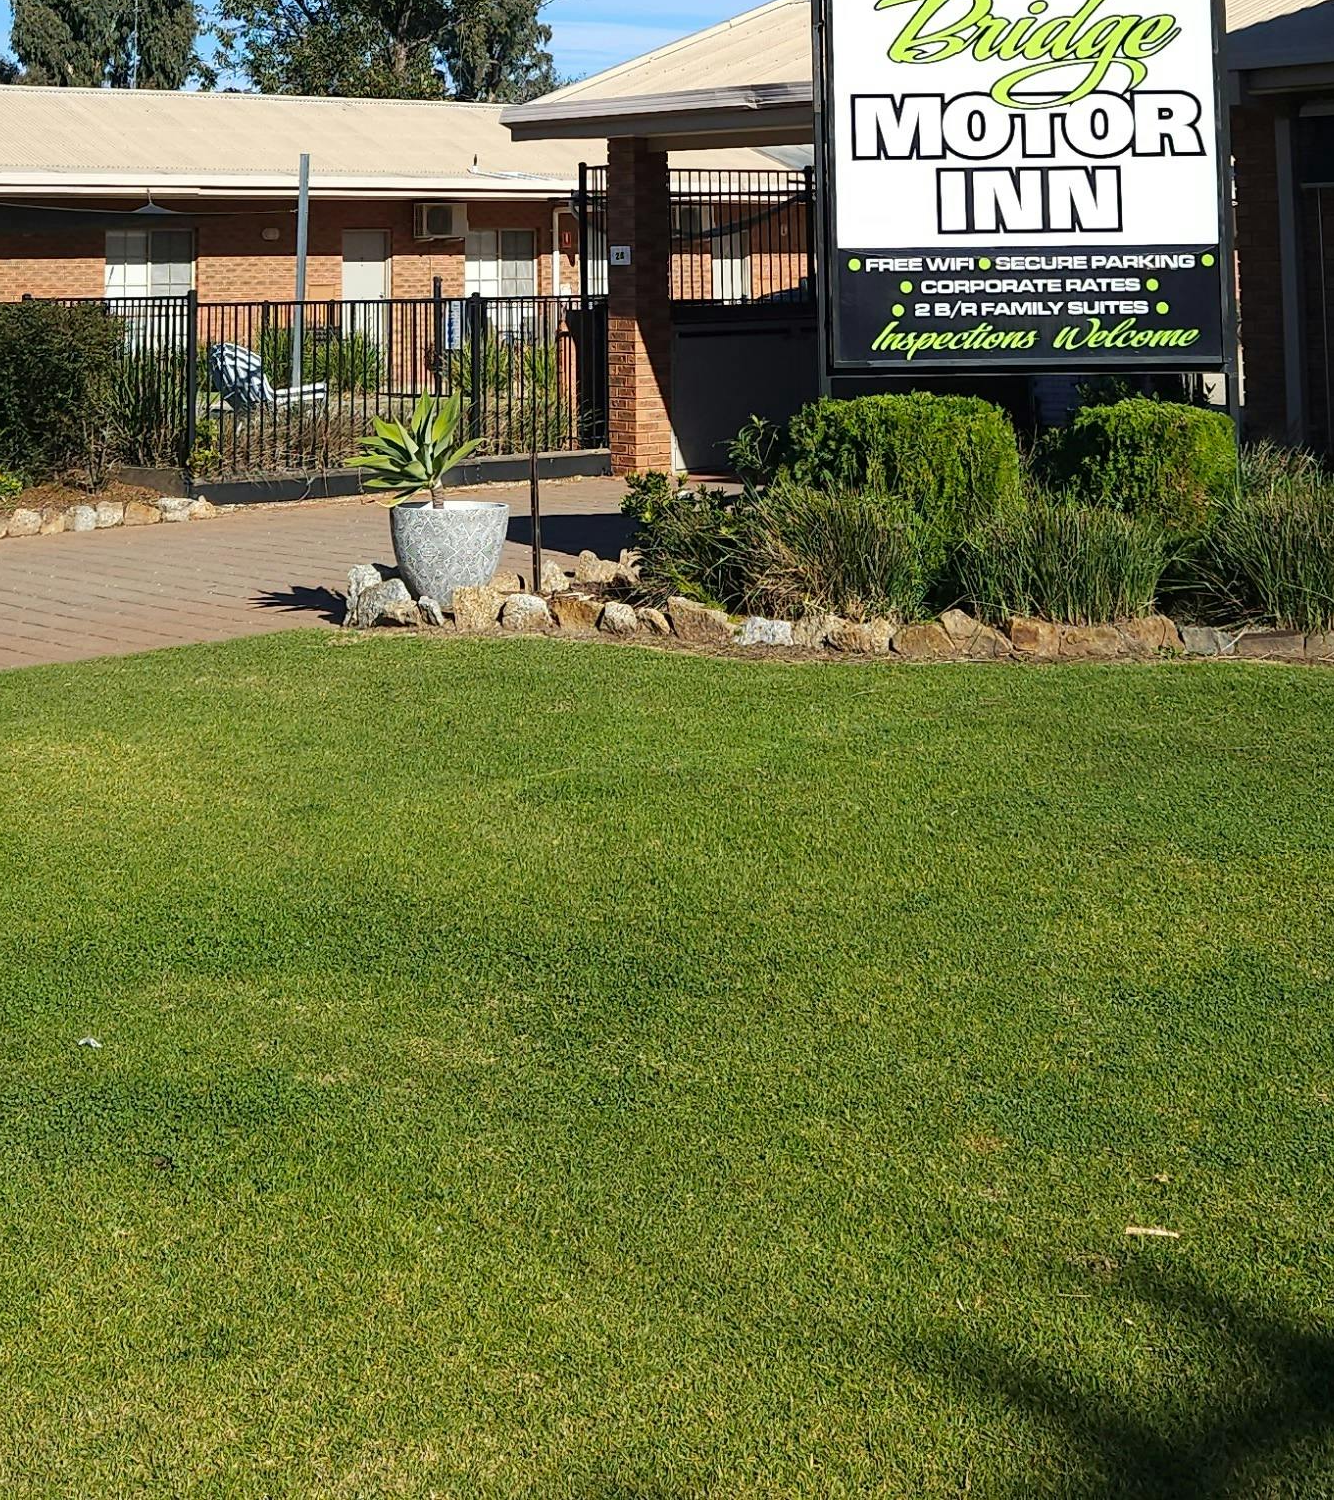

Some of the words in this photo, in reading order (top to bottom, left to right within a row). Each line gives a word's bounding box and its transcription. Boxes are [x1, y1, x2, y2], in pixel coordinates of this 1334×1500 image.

[851, 90, 1207, 160] MOTOR
[936, 166, 1123, 234] INN
[865, 257, 923, 272] FREE
[925, 257, 974, 272] WIFI
[995, 256, 1088, 271] SECURE
[1091, 254, 1196, 270] PARKING
[920, 279, 1062, 294] CORPORATE
[1065, 278, 1141, 292] RATES
[914, 303, 932, 317] 2
[934, 301, 978, 318] B/R
[981, 302, 1065, 316] FAMILY
[1067, 300, 1149, 315] SUITES
[871, 321, 1038, 361] Inspections
[1053, 318, 1199, 350] Welcome
